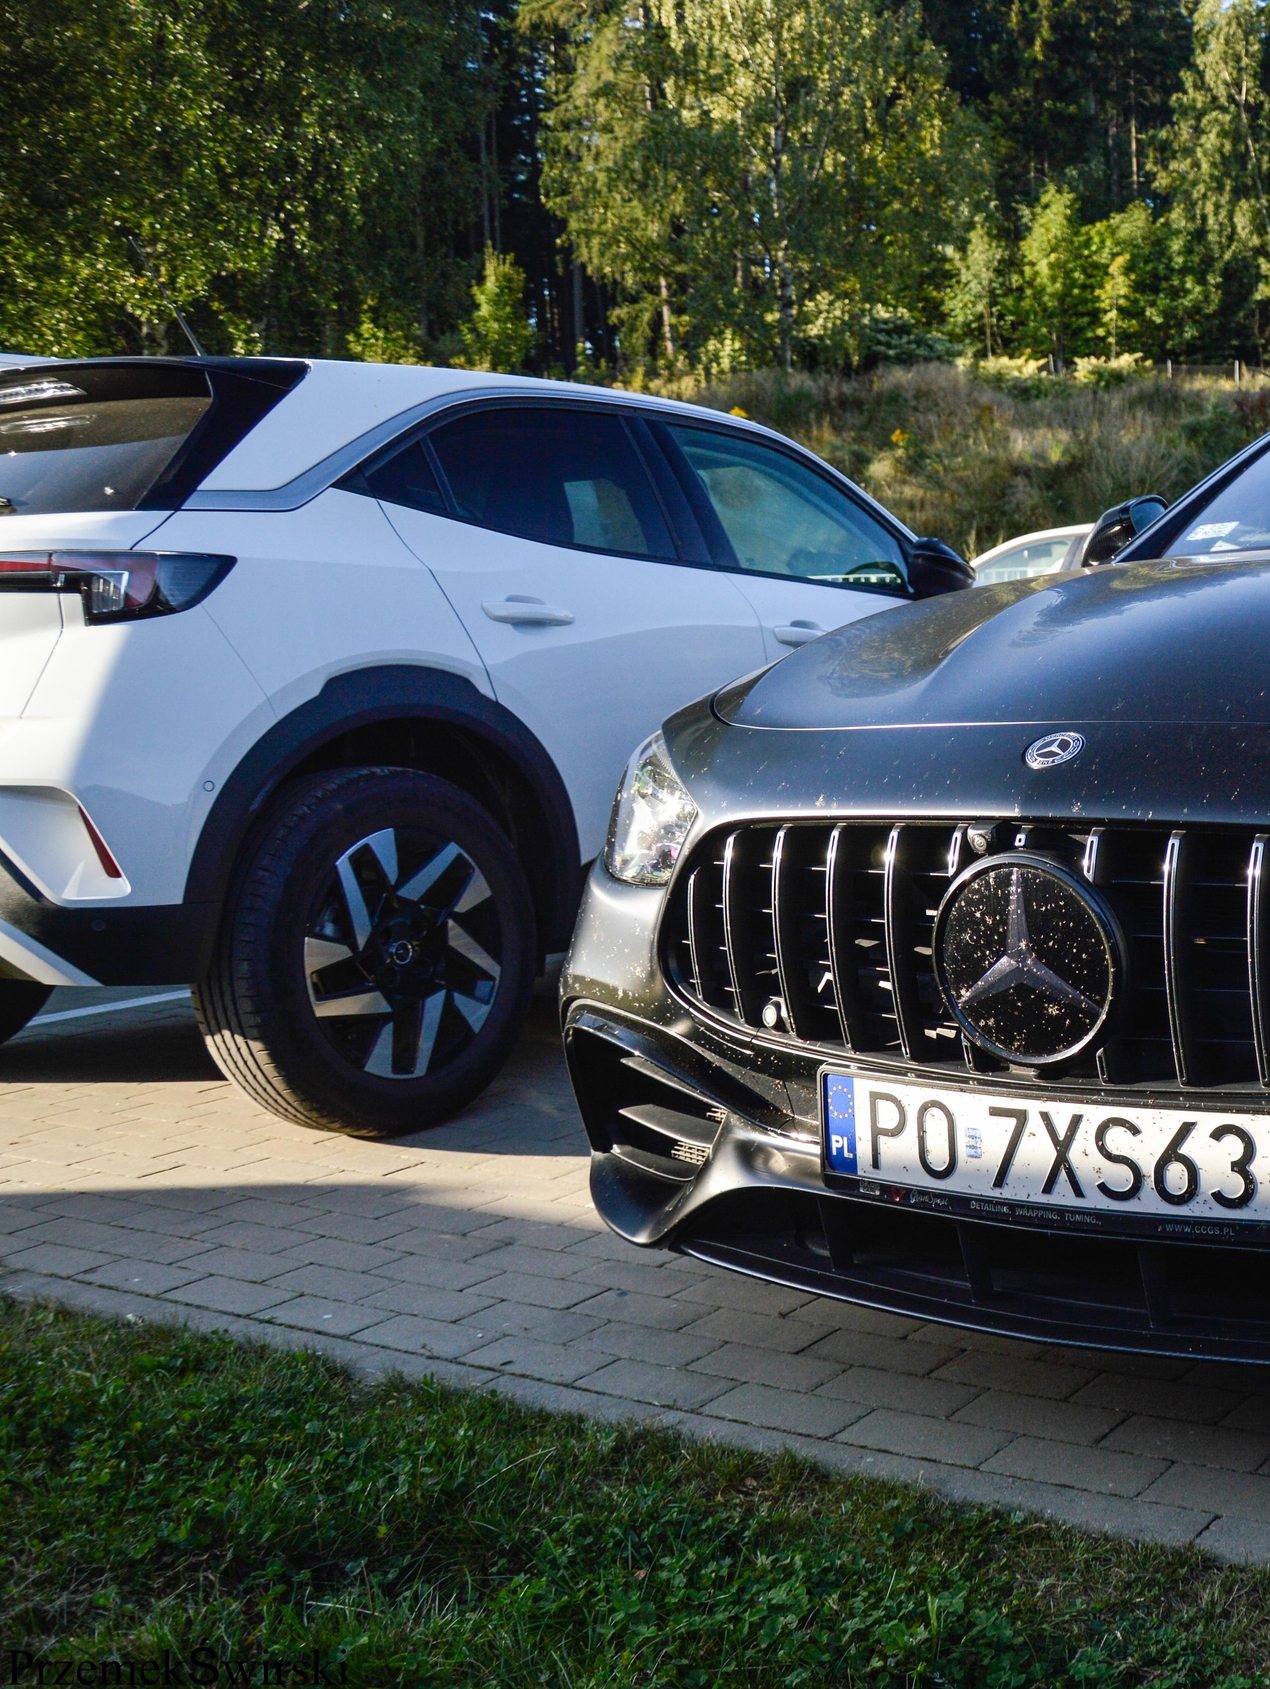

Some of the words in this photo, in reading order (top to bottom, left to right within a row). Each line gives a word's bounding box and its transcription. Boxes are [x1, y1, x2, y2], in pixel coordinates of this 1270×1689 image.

[831, 1134, 854, 1159] PL
[869, 1091, 957, 1180] PO
[988, 1107, 1258, 1210] 7XS63
[970, 1200, 1012, 1214] DETAILING.
[1015, 1206, 1060, 1220] WRAPPING.
[1165, 1223, 1235, 1236] WWW.CCGS.PL
